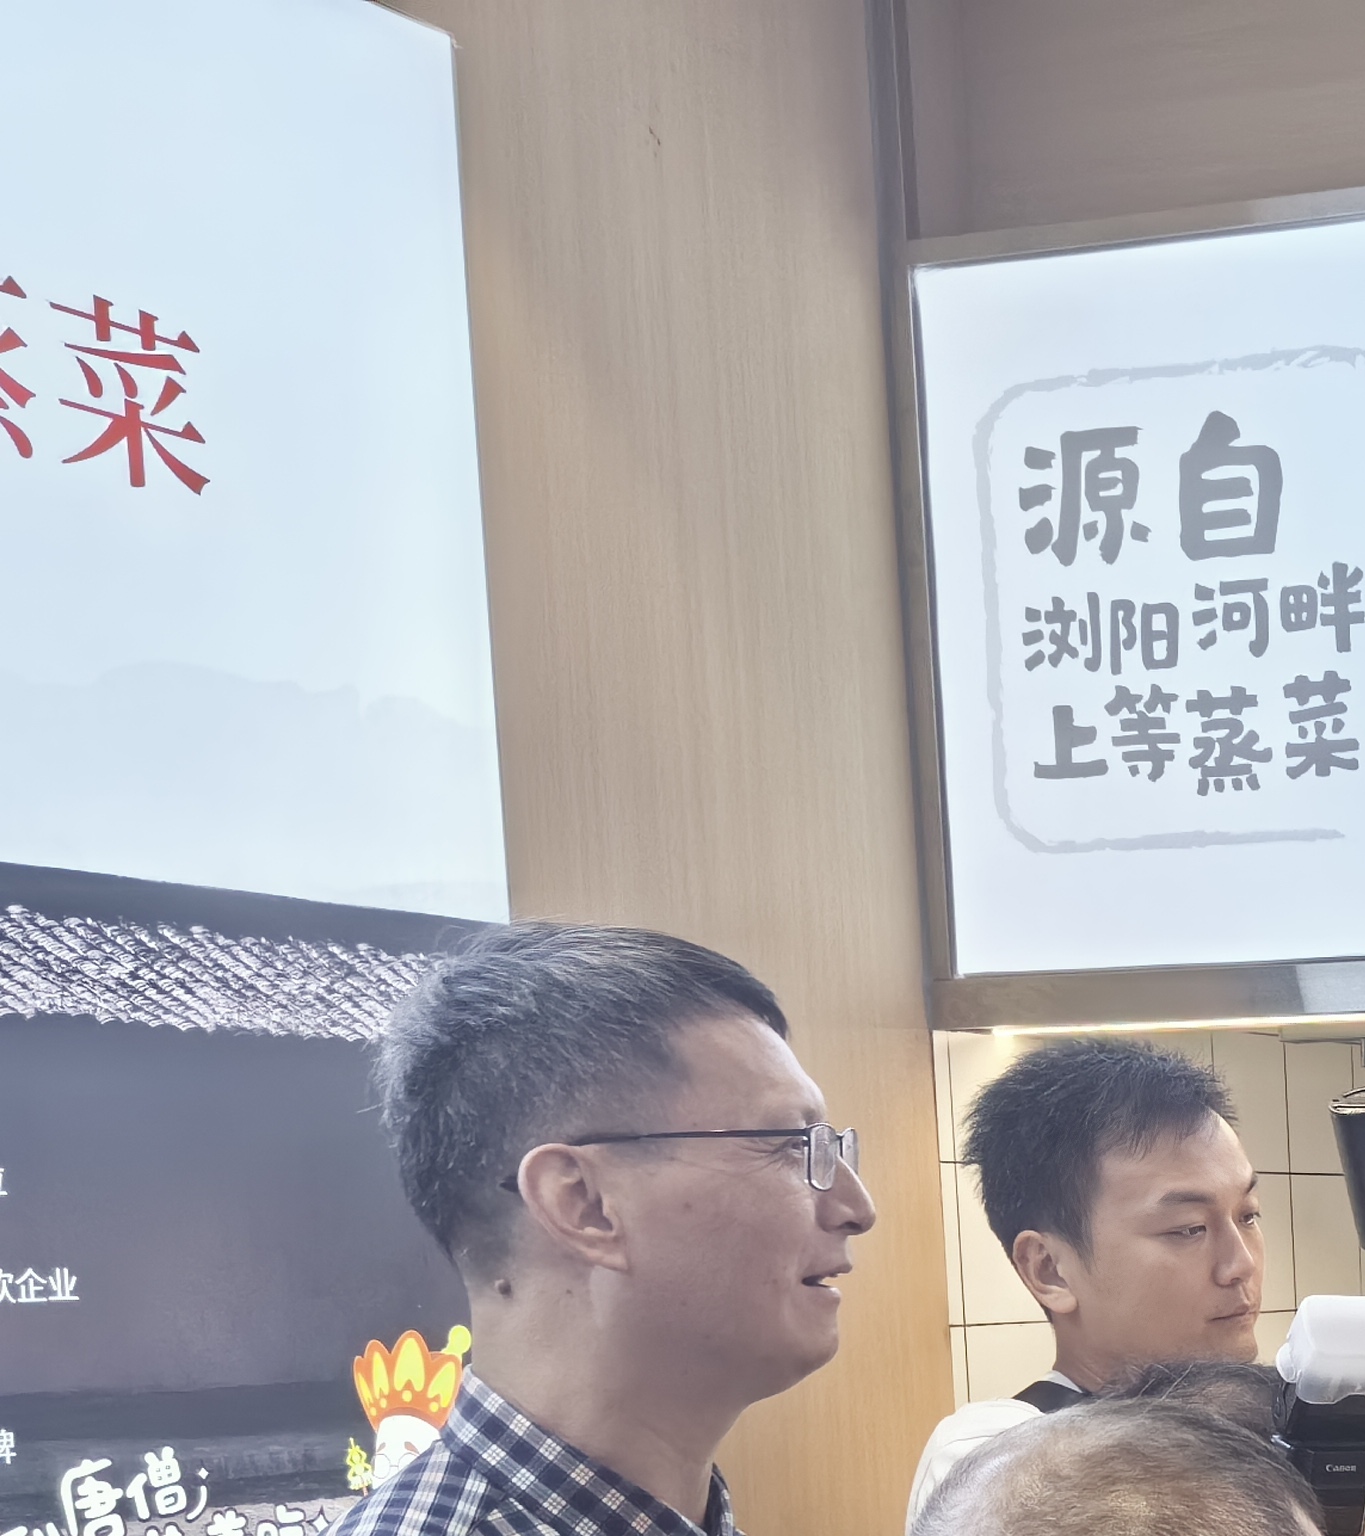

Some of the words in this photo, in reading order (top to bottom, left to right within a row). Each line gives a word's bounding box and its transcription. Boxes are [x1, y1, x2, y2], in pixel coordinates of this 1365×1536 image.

[1018, 410, 1284, 566] 源自
[1022, 561, 1365, 675] 浏阳河畔
[1033, 670, 1361, 797] 上等蒸菜
[1325, 1463, 1357, 1473] Canon
